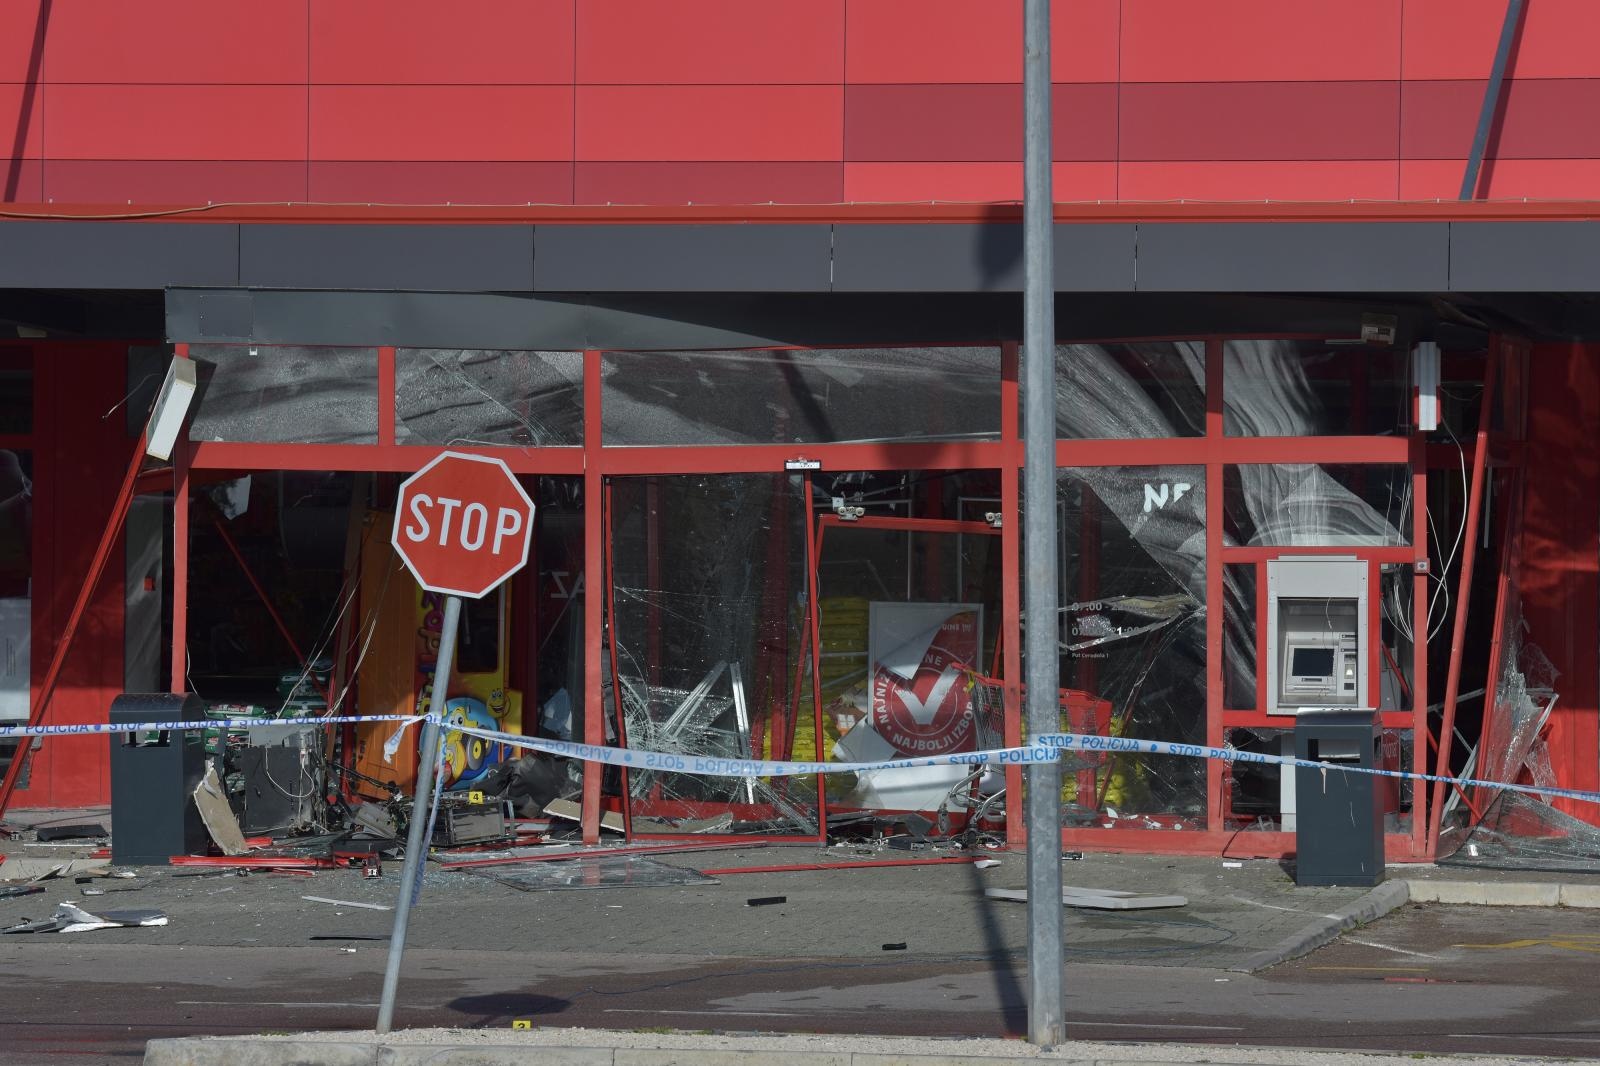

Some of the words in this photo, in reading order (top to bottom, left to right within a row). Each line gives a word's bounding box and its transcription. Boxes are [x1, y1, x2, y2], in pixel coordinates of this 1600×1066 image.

[405, 493, 522, 555] STOP
[1072, 602, 1102, 611] 0:00
[892, 733, 953, 751] NAJBOLJI
[1038, 735, 1073, 748] STOP
[1081, 736, 1140, 751] POLICIJA
[1169, 744, 1202, 757] STOP
[949, 753, 989, 766] STOP
[999, 746, 1062, 763] POLICIJA
[473, 793, 479, 801] 4
